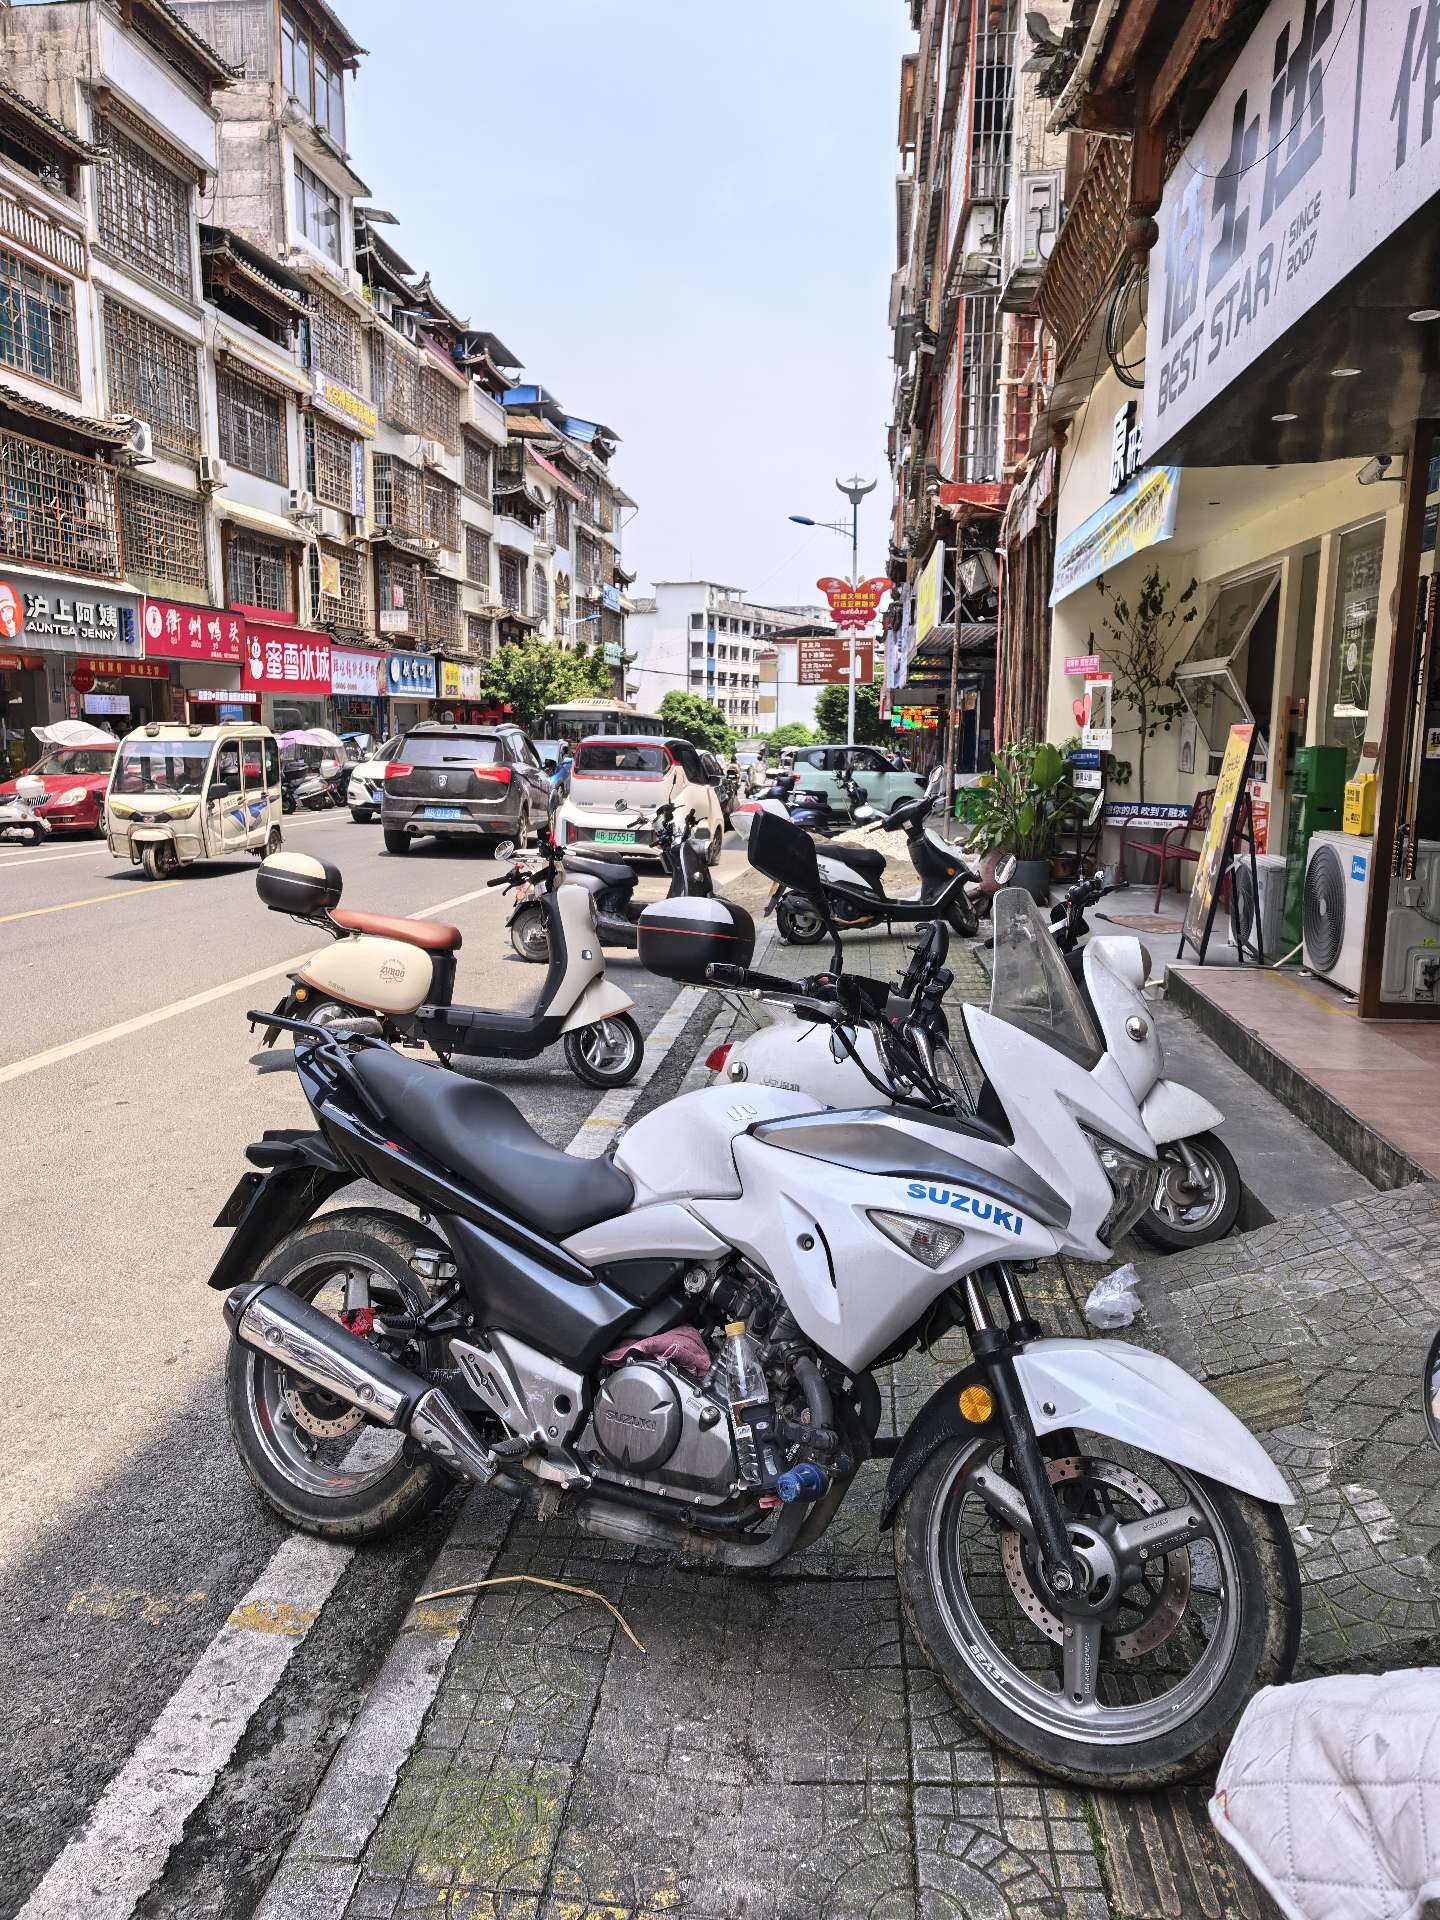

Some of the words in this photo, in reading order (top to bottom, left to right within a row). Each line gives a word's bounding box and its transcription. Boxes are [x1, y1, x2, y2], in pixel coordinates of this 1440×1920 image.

[1288, 190, 1322, 249] SINCE
[1286, 229, 1318, 282] 2007
[1157, 319, 1206, 418] BEST
[1207, 242, 1275, 367] STAR
[24, 593, 118, 628] 沪上阿姨
[165, 608, 240, 644] 衢州鸭头
[26, 621, 77, 637] AUNTEA
[81, 628, 118, 641] JENNY
[265, 640, 330, 681] 蜜雪冰城
[1140, 805, 1188, 818] 吹到了融水
[906, 1183, 1023, 1235] SUZUKI
[605, 1409, 657, 1432] SUZUKI
[969, 1644, 1009, 1684] BEAST
